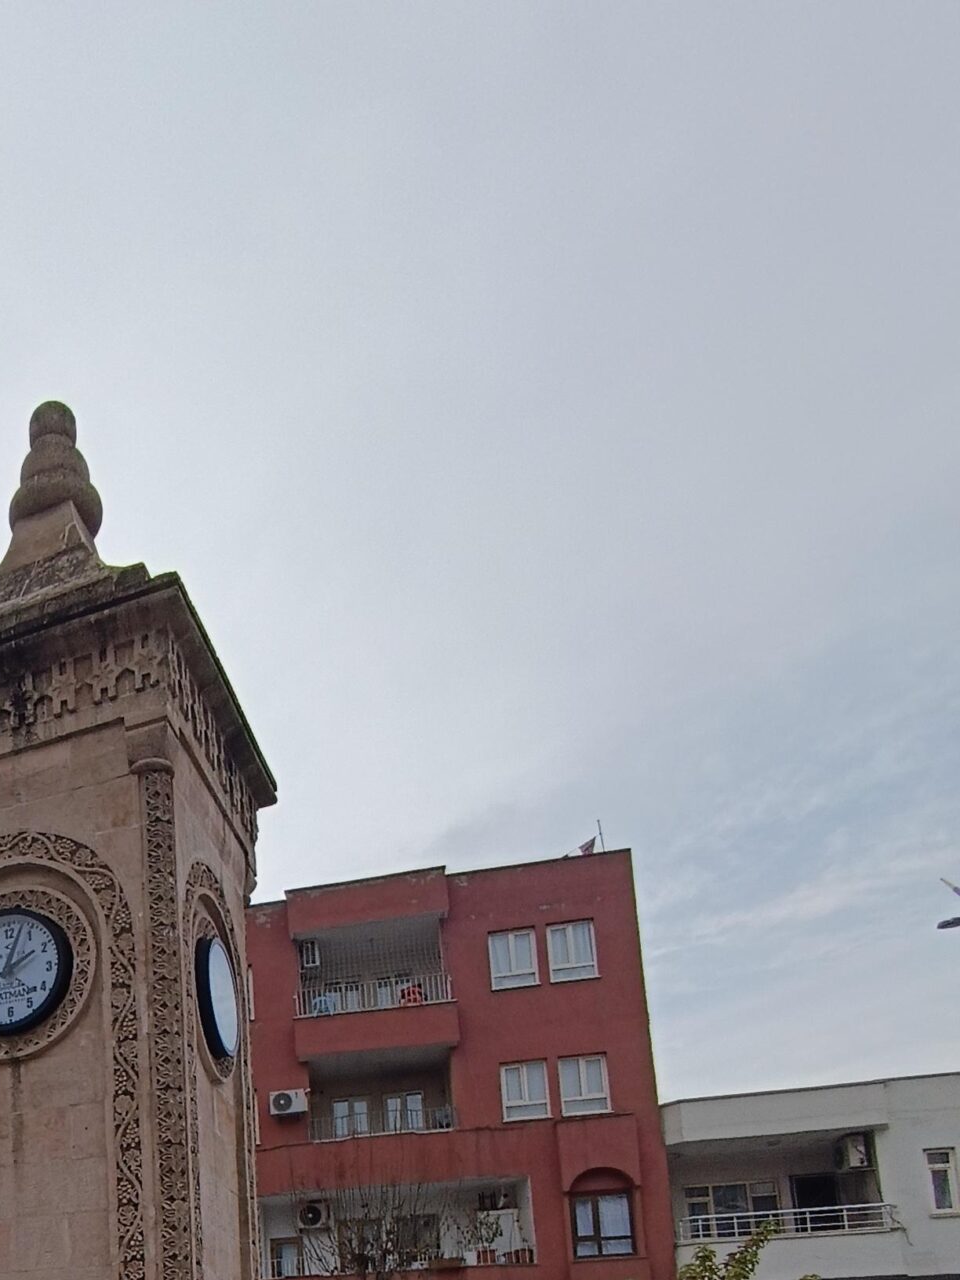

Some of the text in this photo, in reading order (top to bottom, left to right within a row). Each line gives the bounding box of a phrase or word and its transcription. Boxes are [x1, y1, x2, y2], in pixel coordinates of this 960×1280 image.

[4, 928, 14, 939] 12
[27, 930, 32, 941] 1
[41, 942, 48, 953] 2
[46, 961, 53, 972] 3
[40, 981, 47, 992] 4
[27, 997, 33, 1008] 5
[7, 1006, 14, 1017] 6
